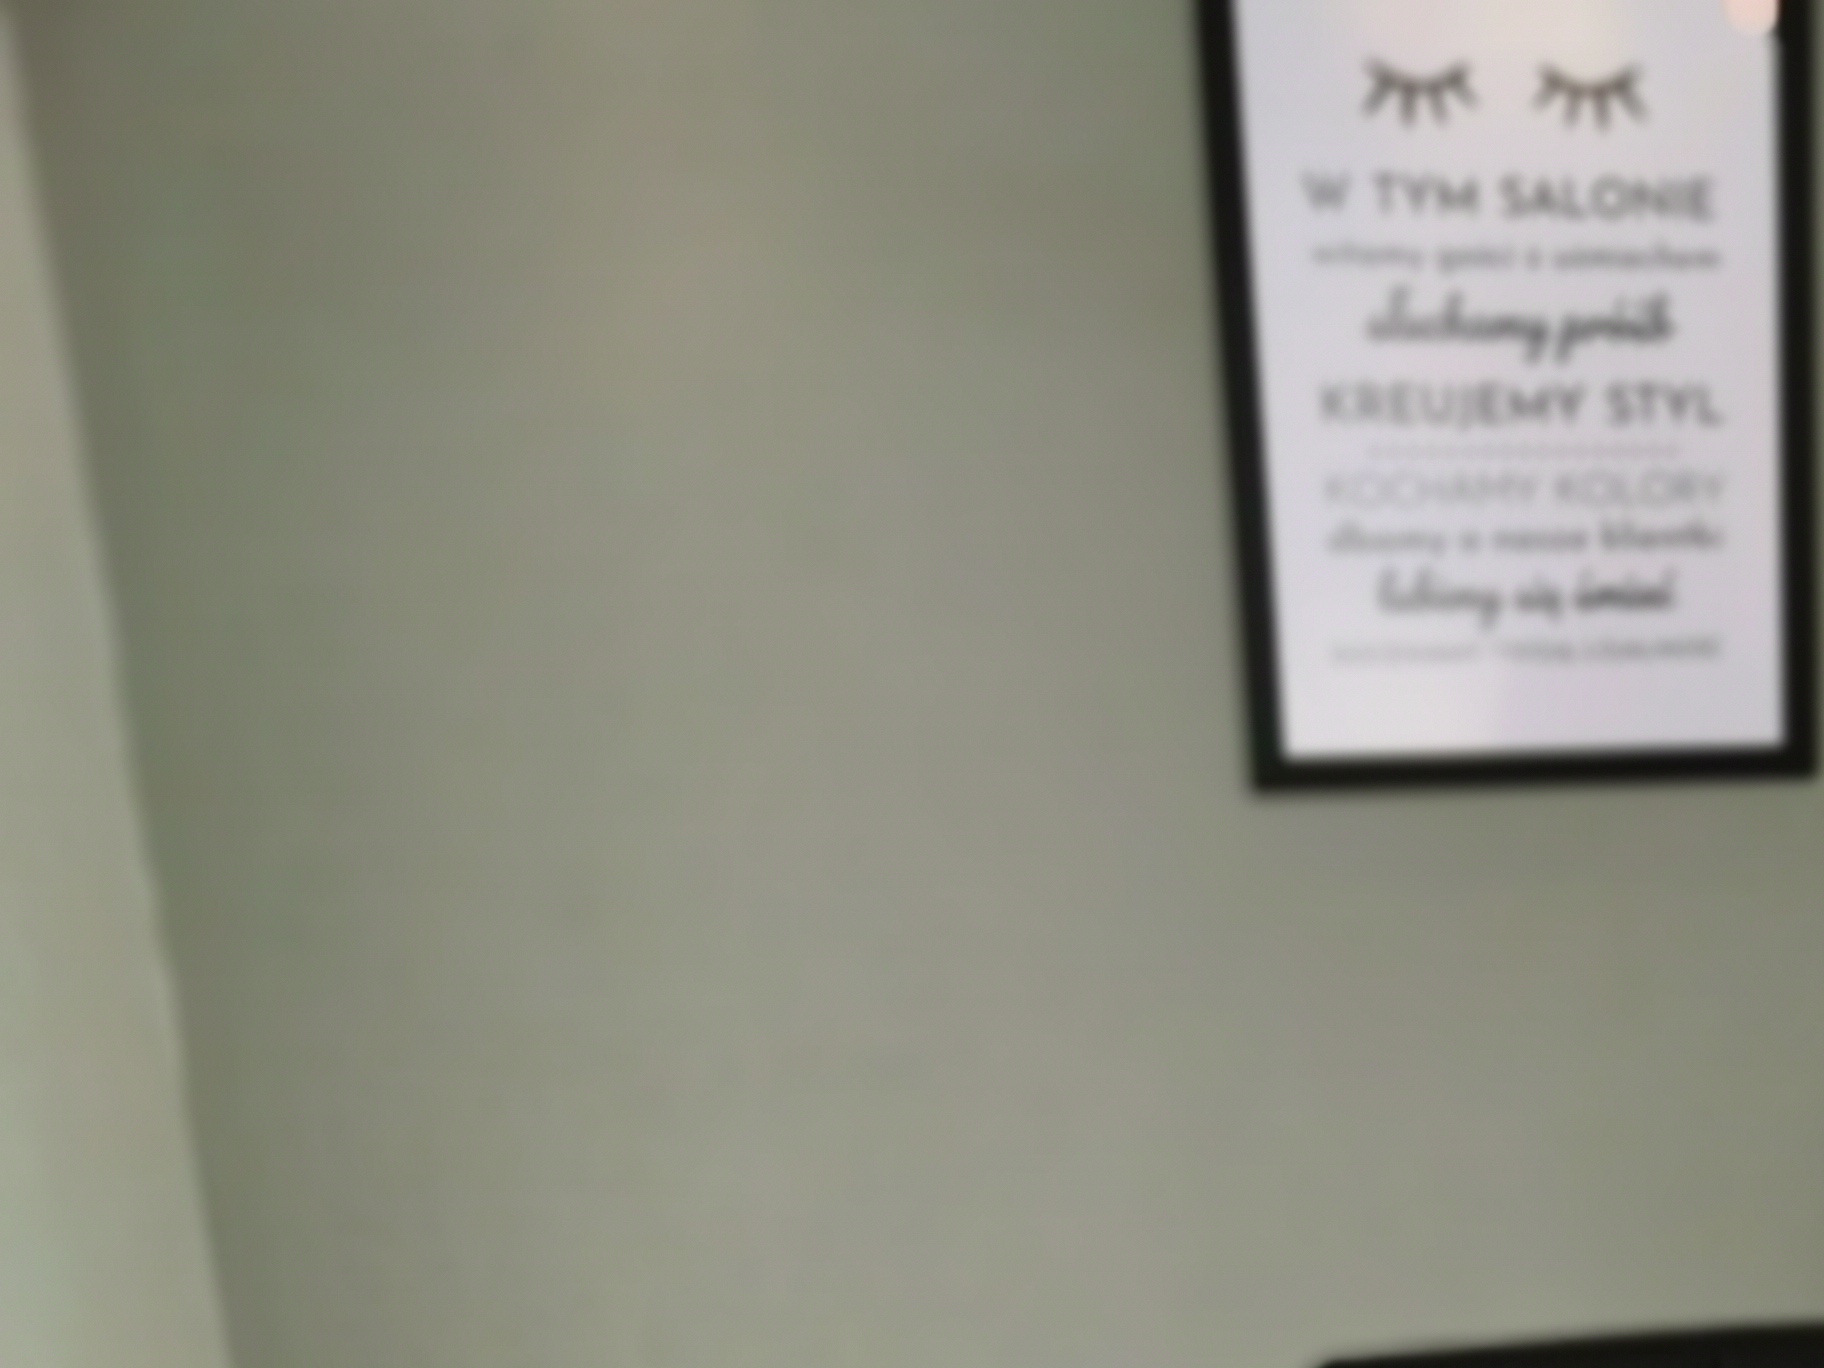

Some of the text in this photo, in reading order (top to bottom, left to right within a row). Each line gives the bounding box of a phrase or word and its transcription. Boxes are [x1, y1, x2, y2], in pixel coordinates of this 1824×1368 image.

[1301, 173, 1716, 223] W TYM SALONIE
[1320, 382, 1723, 432] KREUJEMY STYL
[1324, 471, 1726, 507] KOCHAMY KOLORY
